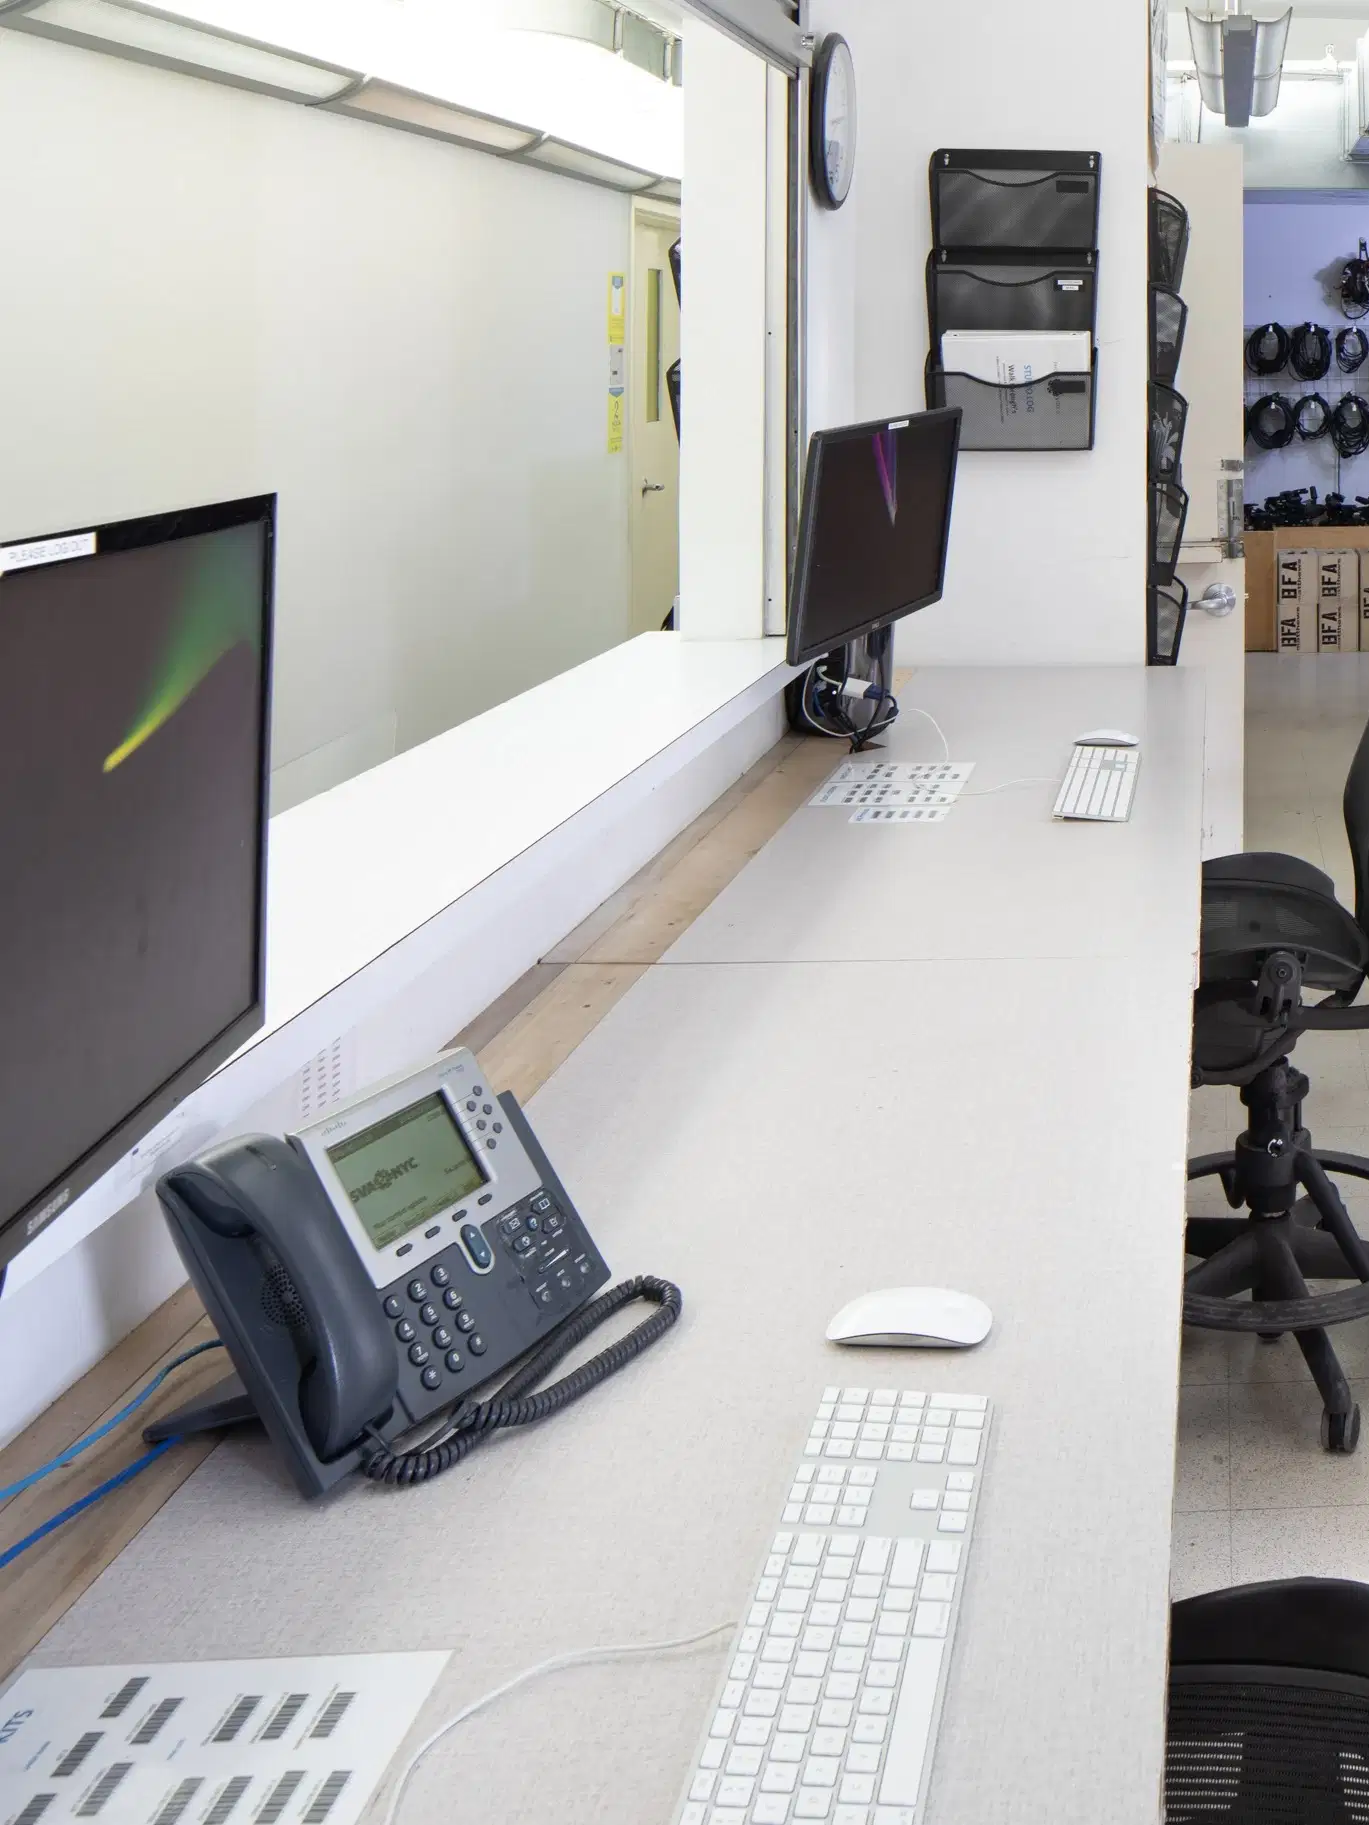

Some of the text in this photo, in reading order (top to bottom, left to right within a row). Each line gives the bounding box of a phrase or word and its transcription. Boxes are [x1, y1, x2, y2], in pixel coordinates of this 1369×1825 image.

[1281, 561, 1297, 599] BFA
[1322, 564, 1337, 597] BFA
[1281, 618, 1297, 647] BFA
[1322, 612, 1337, 645] BFA
[350, 1181, 375, 1203] SVA
[389, 1156, 419, 1181] NYC
[437, 1267, 445, 1276] 3
[414, 1283, 422, 1292] 2
[450, 1291, 457, 1300] 6
[391, 1299, 398, 1308] 1
[427, 1306, 434, 1315] 5
[462, 1314, 469, 1323] 9
[404, 1323, 410, 1331] 4
[440, 1329, 447, 1338] 8
[415, 1346, 422, 1355] 7
[452, 1353, 459, 1362] 0
